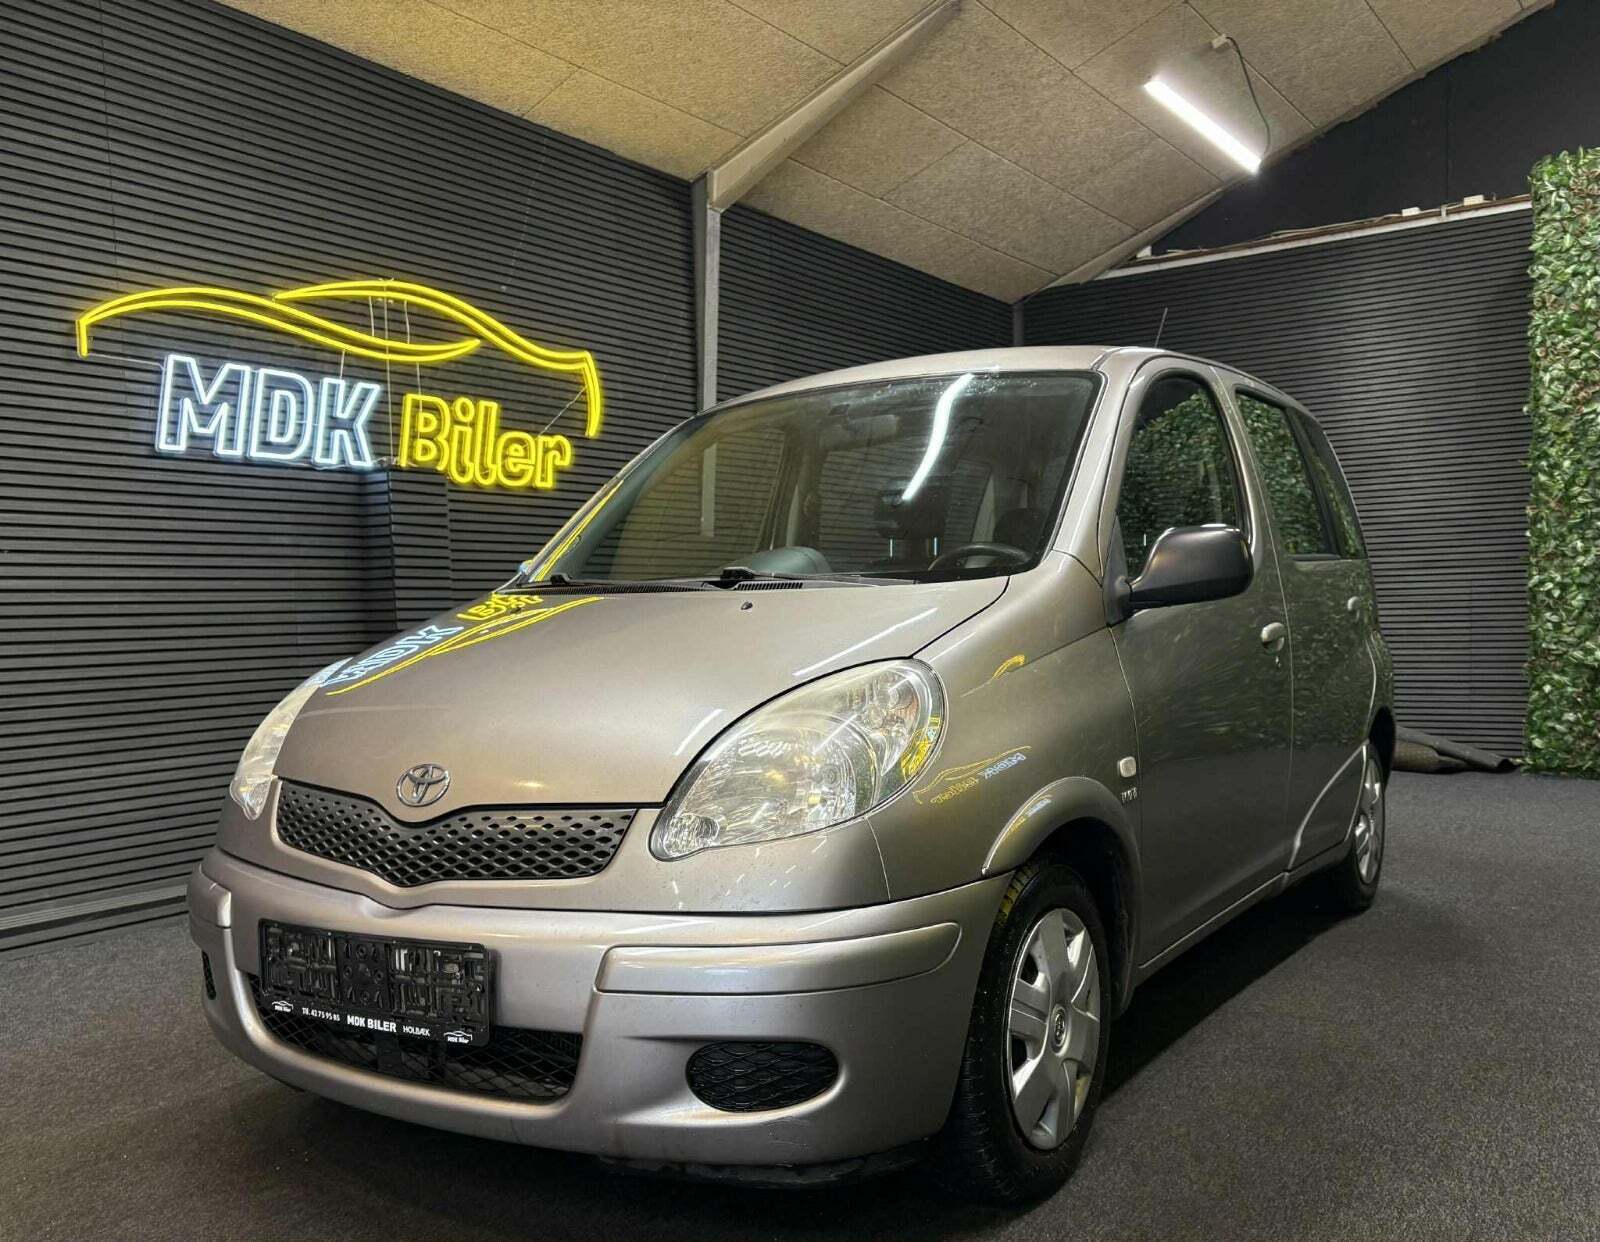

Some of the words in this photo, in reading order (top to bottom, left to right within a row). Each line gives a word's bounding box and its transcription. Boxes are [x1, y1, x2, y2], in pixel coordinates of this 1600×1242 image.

[155, 353, 382, 469] MDK
[399, 392, 572, 489] Biler
[346, 1014, 366, 1028] MDK
[367, 1018, 397, 1033] BILER
